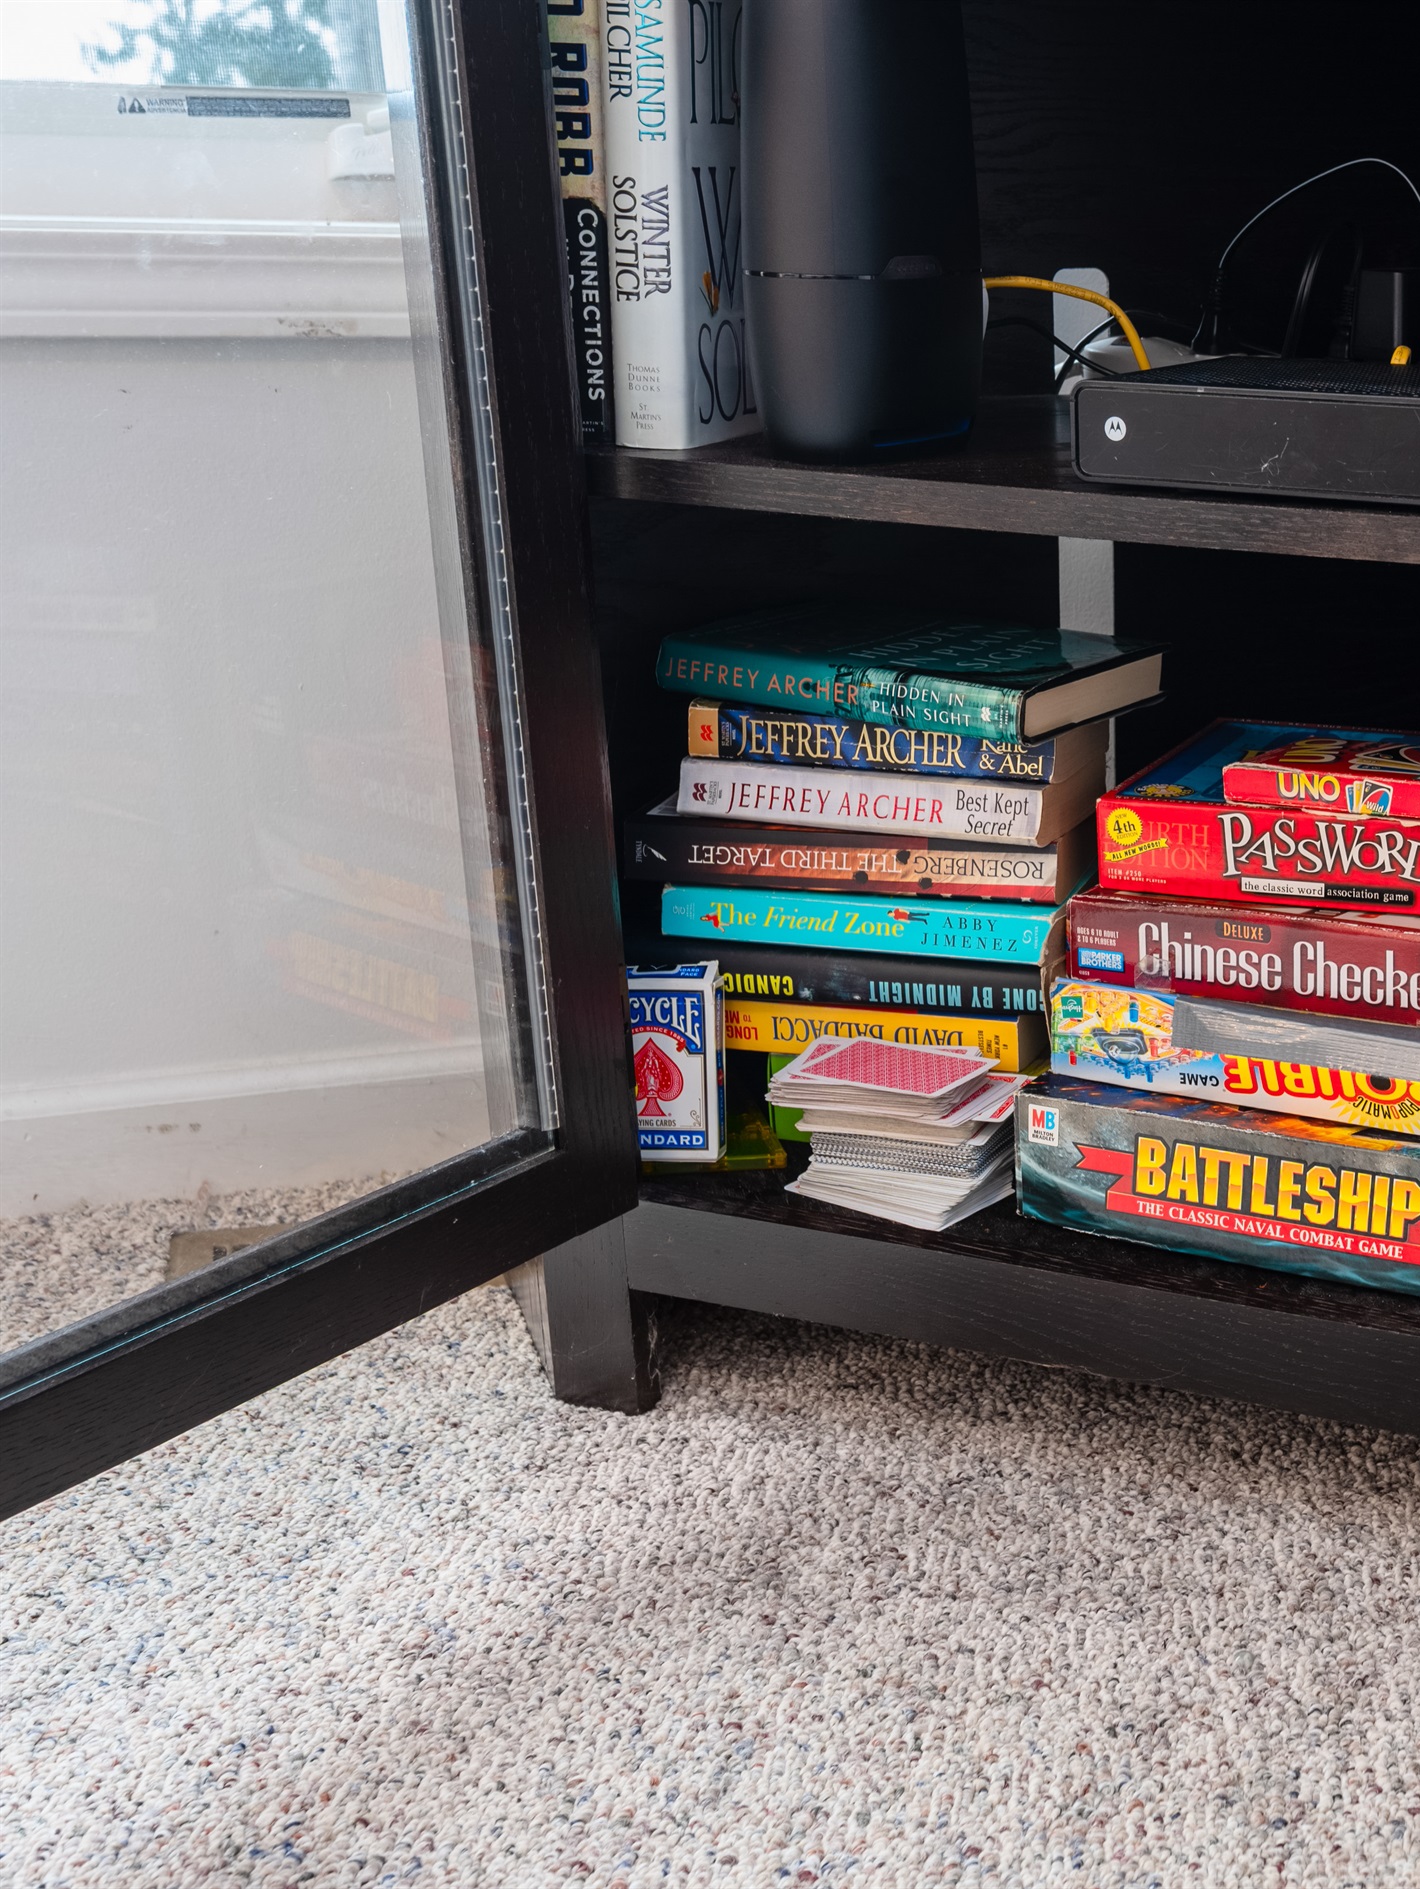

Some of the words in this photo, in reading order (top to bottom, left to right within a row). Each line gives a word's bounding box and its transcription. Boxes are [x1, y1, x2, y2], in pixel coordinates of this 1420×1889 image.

[612, 175, 641, 302] SOLSTICE
[641, 184, 672, 299] WINTER
[577, 208, 606, 401] CONNECTIONS
[627, 363, 661, 374] THOMAS
[627, 373, 661, 383] DUNNE
[628, 383, 661, 392] BOOKS
[636, 421, 654, 431] PRESS
[665, 657, 760, 689] JEFFREY
[767, 673, 859, 706] ARCHER
[879, 682, 940, 704] HIDDEN
[947, 692, 966, 708] IN
[871, 700, 916, 719] PLAIN
[923, 708, 972, 728] SIGHT
[736, 715, 850, 759] JEFFREY
[852, 722, 966, 769] ARCHER
[1278, 737, 1349, 764] UNO
[978, 753, 996, 771] &
[997, 754, 1044, 777] Abel
[1275, 772, 1341, 803] UNO
[725, 782, 832, 814] JEFFREY
[837, 791, 943, 824] ARCHER
[955, 789, 989, 813] Best
[994, 792, 1030, 821] Kept
[1365, 801, 1385, 813] Wild
[964, 813, 1014, 837] Secret
[1112, 819, 1137, 835] 4th
[687, 844, 776, 868] TARGET
[780, 849, 852, 871] THIRD
[857, 852, 903, 874] THE
[1124, 847, 1137, 857] NEW
[913, 855, 1045, 881] ROSENBERG
[1107, 868, 1123, 876] ITEM
[1244, 881, 1260, 892] the
[1262, 883, 1294, 894] classic
[1297, 885, 1324, 897] word
[1326, 888, 1380, 900] association
[1382, 892, 1410, 903] game
[710, 901, 757, 927] The
[762, 905, 839, 933] Friend
[843, 911, 905, 937] Zone
[942, 915, 998, 932] ABBY
[920, 932, 1018, 952] JIMENEZ
[1223, 921, 1265, 942] DELUXE
[1080, 957, 1122, 970] BROTHERS
[1090, 951, 1122, 962] PARKER
[1137, 921, 1283, 992] Chinese
[724, 972, 794, 997] CANDIC
[868, 980, 962, 1007] MIDNIGHT
[971, 986, 994, 1009] BY
[630, 997, 701, 1050] CYCLE
[645, 1026, 669, 1036] SINCE
[725, 1025, 759, 1041] LONG
[772, 1015, 883, 1043] BALDACCI
[893, 1026, 964, 1047] DAVID
[1179, 1071, 1220, 1087] GAME
[655, 1119, 677, 1127] CARDS
[1031, 1108, 1056, 1131] MB
[640, 1133, 704, 1146] NDARD
[1031, 1133, 1056, 1142] BRADLEY
[1033, 1129, 1055, 1138] MILTON
[1136, 1200, 1165, 1217] THE
[1168, 1205, 1230, 1229] CLASSIC
[1233, 1217, 1285, 1239] NAVAL
[1289, 1227, 1354, 1250] COMBAT
[1358, 1240, 1404, 1260] GAME
